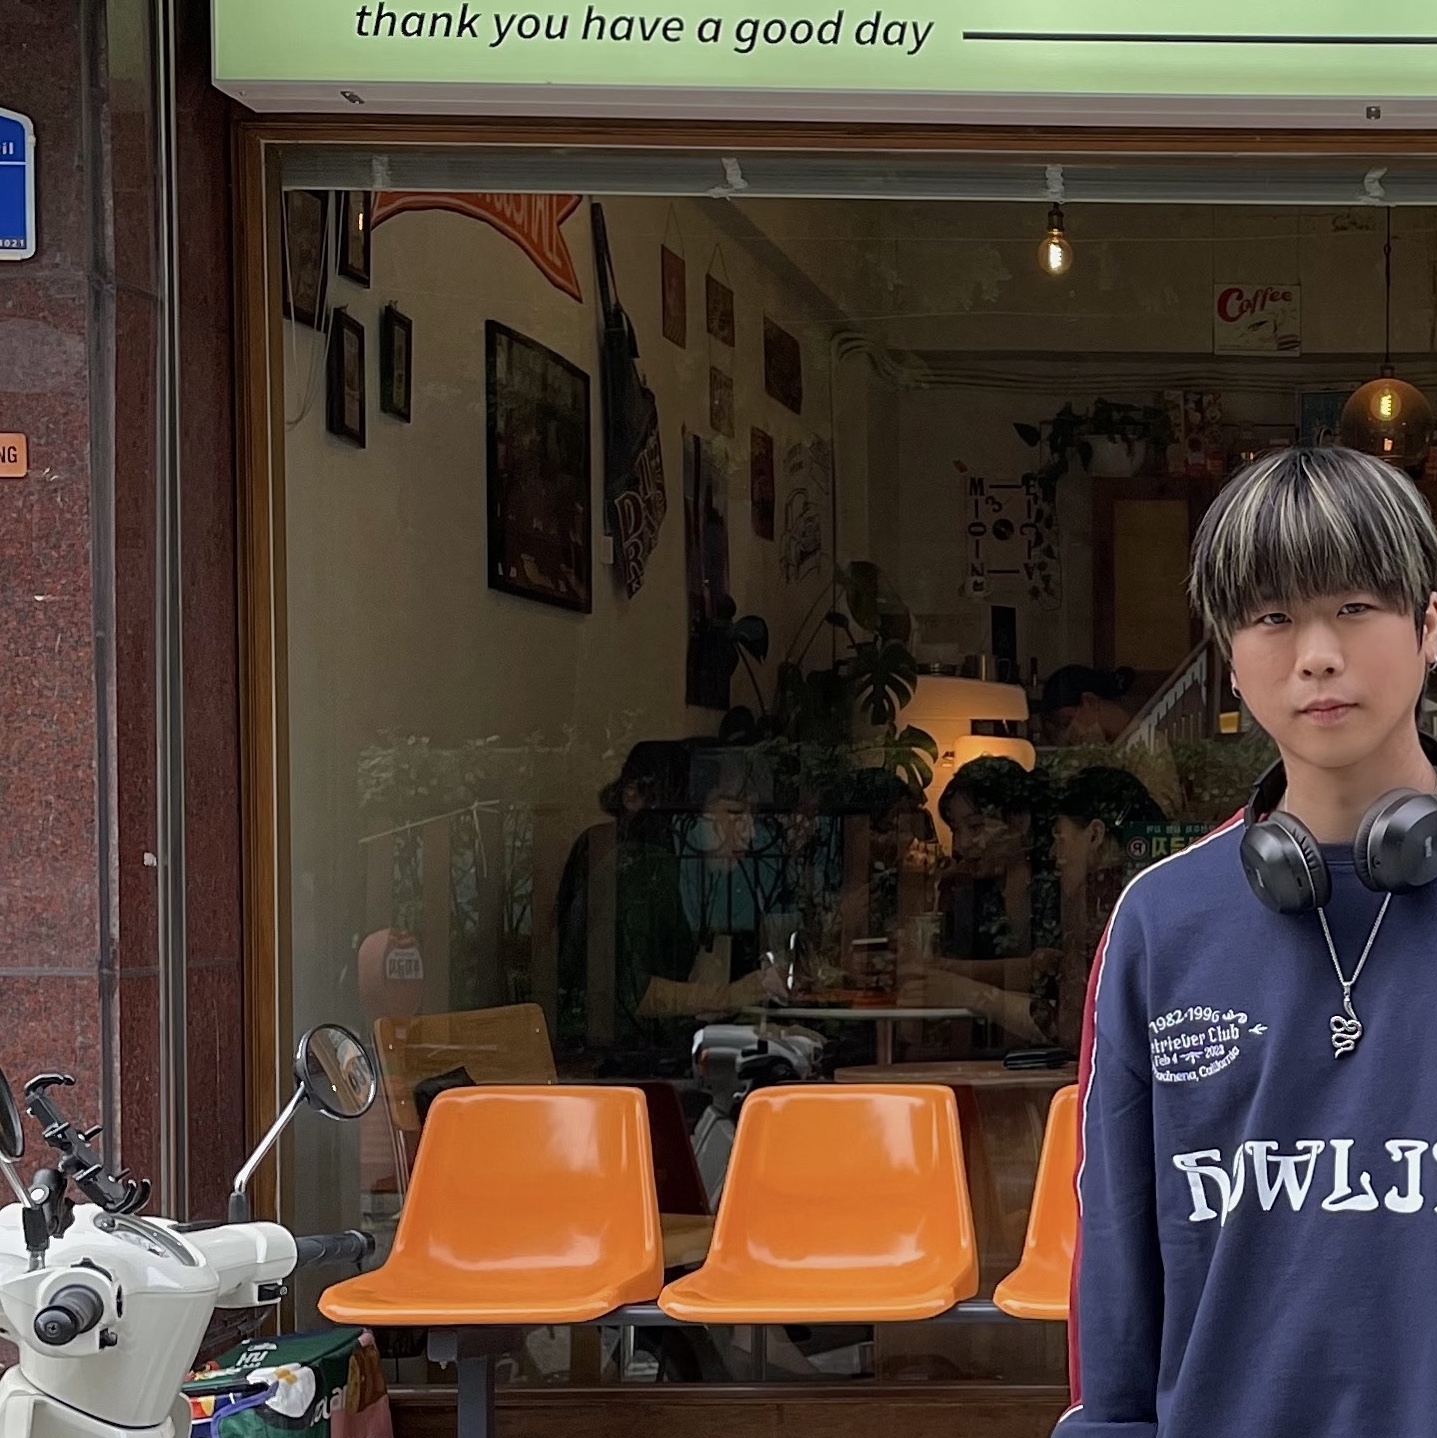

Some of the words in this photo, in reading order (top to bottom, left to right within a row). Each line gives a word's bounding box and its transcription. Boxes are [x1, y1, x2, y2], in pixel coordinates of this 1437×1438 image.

[356, 2, 479, 39] thank
[490, 12, 569, 48] you
[582, 5, 685, 43] have
[697, 17, 723, 43] a
[734, 10, 845, 54] good
[855, 11, 935, 55] day
[0, 141, 14, 155] il
[1217, 286, 1293, 323] Coffee
[1207, 1023, 1240, 1043] Club
